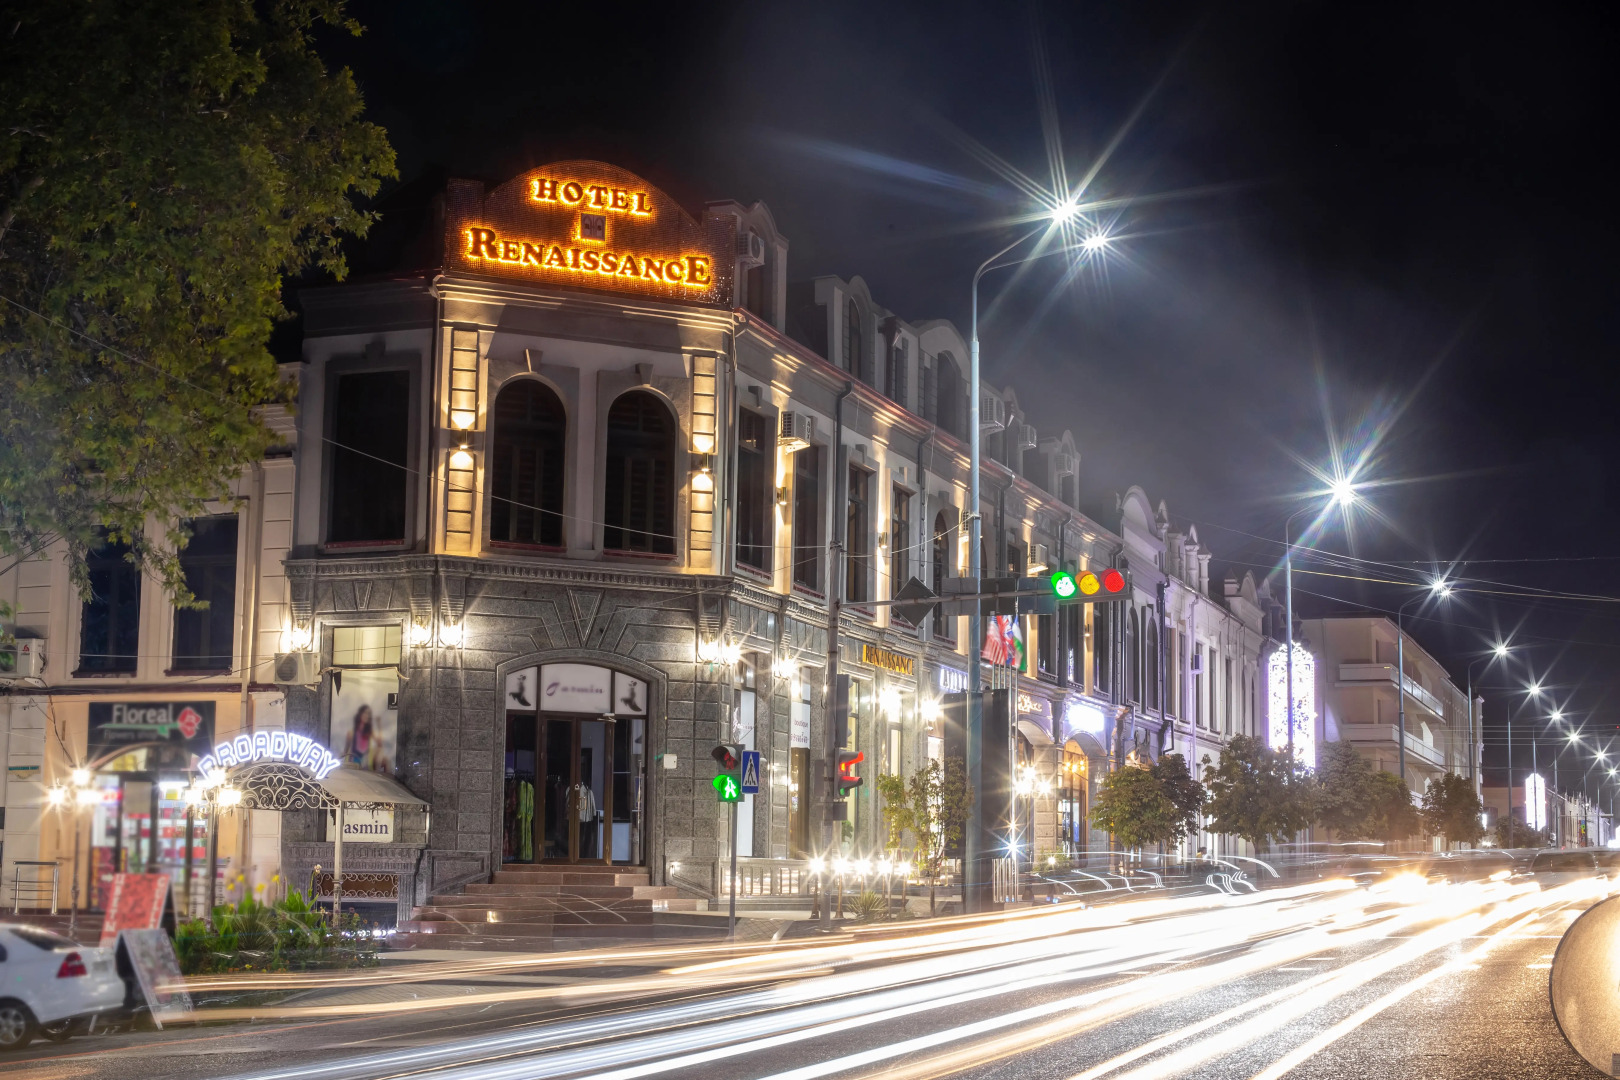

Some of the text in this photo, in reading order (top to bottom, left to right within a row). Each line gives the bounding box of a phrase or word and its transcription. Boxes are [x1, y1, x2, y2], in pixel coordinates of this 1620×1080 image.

[535, 178, 653, 215] HOTEL
[864, 645, 915, 675] RENAISSANCE
[113, 703, 173, 725] Floreal
[342, 820, 389, 835] asmin
